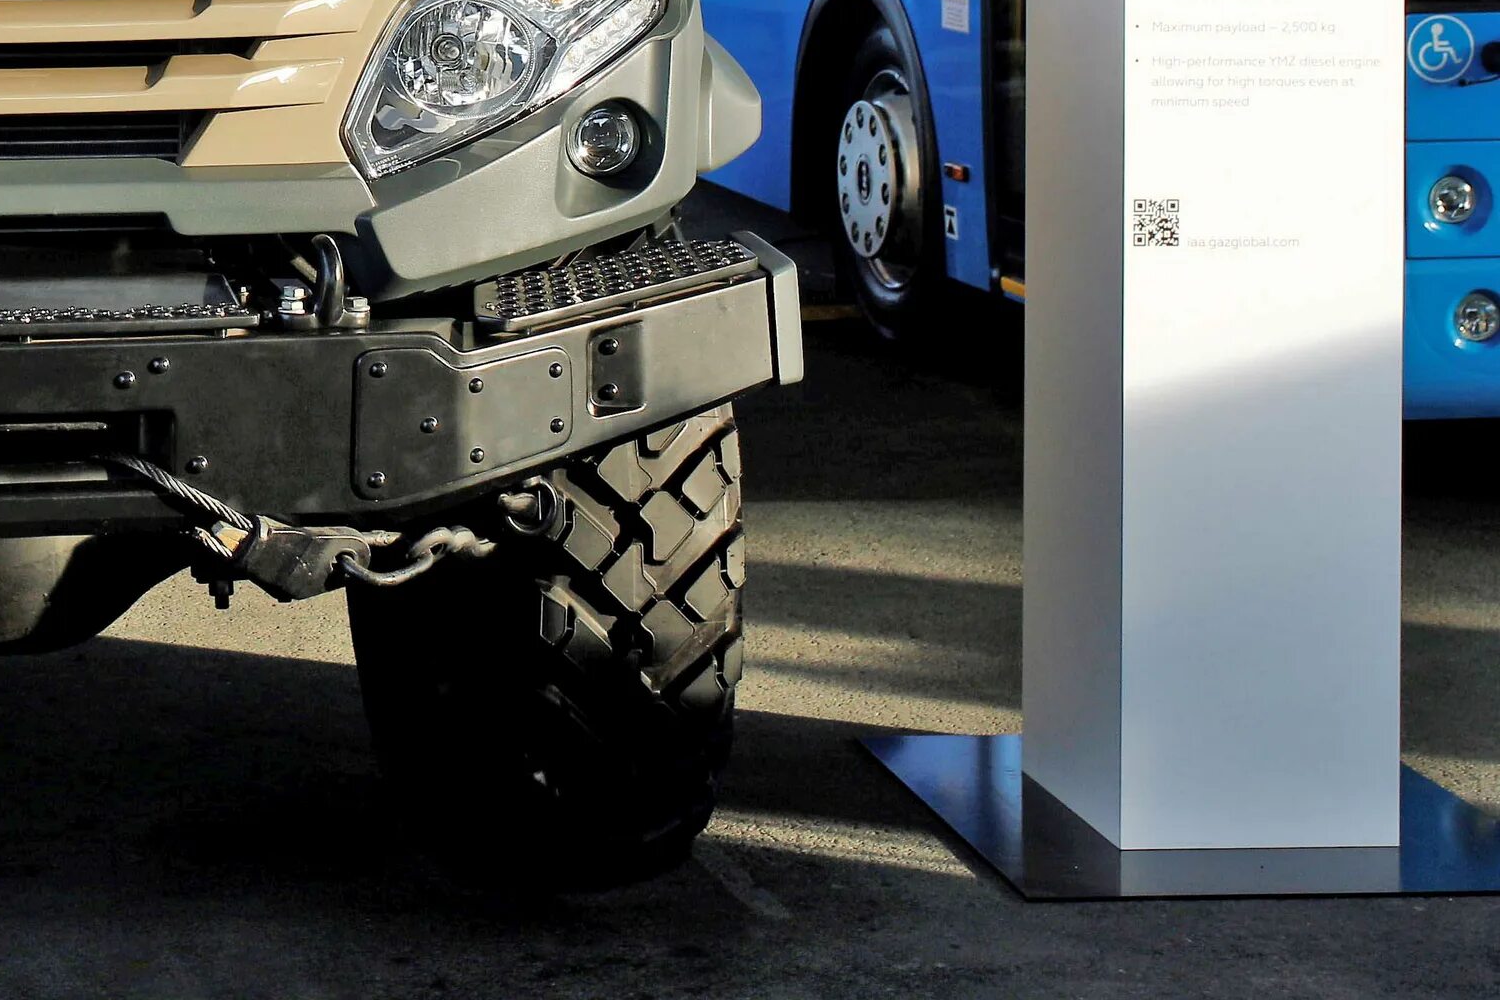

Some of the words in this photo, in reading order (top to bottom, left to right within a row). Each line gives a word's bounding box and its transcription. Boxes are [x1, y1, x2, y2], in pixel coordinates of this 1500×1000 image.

[1152, 21, 1212, 33] Maximum
[1215, 21, 1266, 35] payload
[1320, 21, 1336, 34] kg
[1152, 55, 1266, 69] High-performance
[1299, 56, 1336, 67] diesel
[1338, 58, 1381, 69] engine
[1151, 75, 1204, 89] allowing
[1207, 76, 1224, 87] for
[1227, 77, 1255, 89] high
[1258, 77, 1306, 89] torques
[1308, 79, 1339, 87] even
[1341, 77, 1355, 87] at
[1151, 96, 1209, 107] minimum
[1212, 97, 1250, 110] speed
